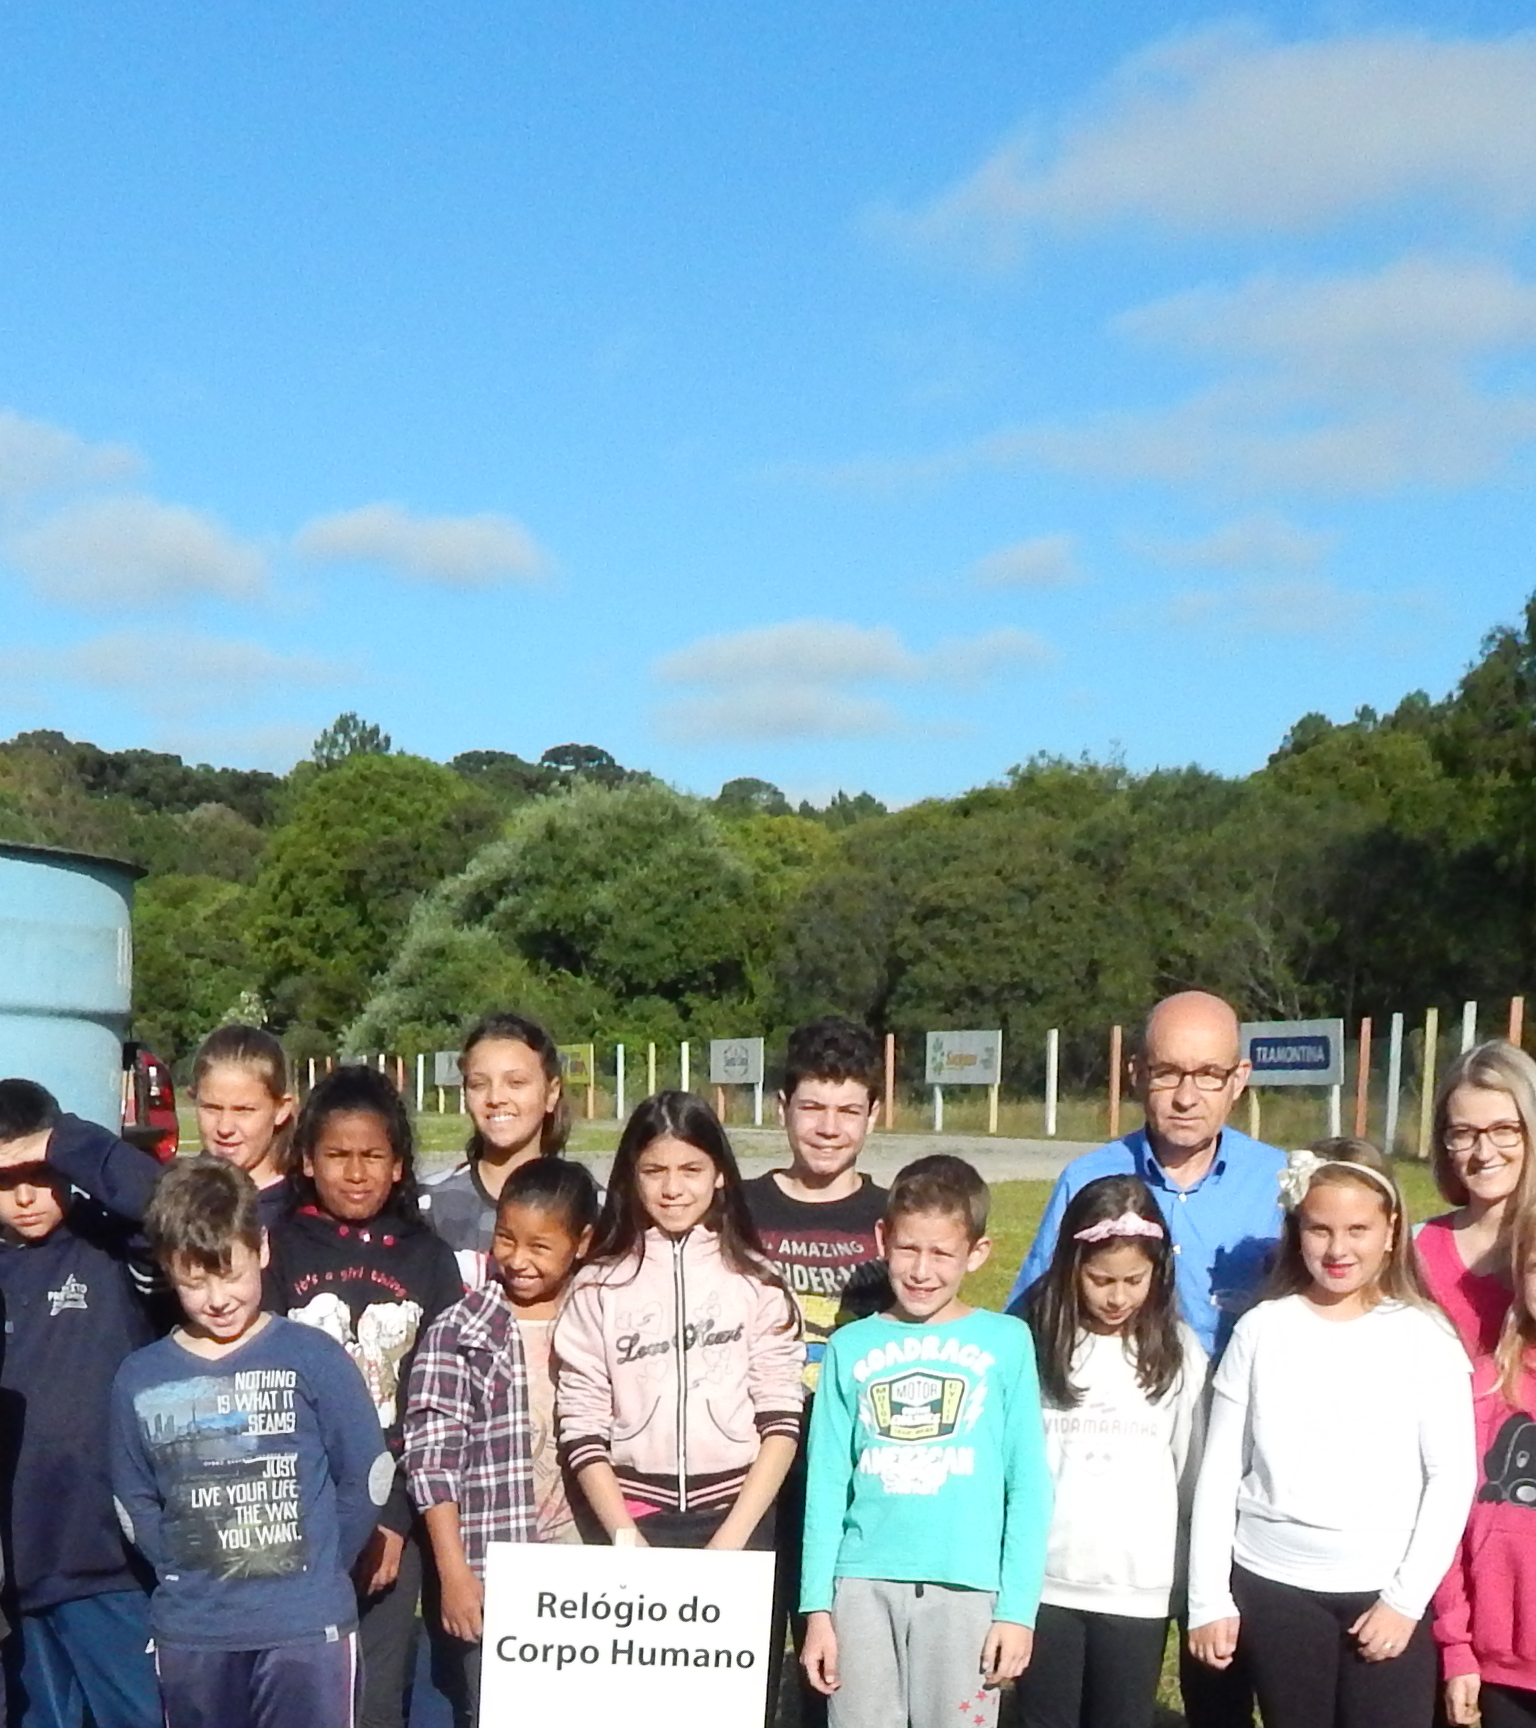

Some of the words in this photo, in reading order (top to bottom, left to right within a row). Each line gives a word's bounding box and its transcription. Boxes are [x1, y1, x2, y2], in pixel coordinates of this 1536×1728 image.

[1256, 1045, 1325, 1063] TRAMONTINA
[778, 1238, 864, 1257] AMAZING
[340, 1266, 364, 1281] girl
[234, 1370, 296, 1390] NOTHING
[217, 1395, 230, 1414] IS
[234, 1390, 278, 1411] WHAT
[283, 1390, 294, 1409] IT
[248, 1412, 296, 1433] SEAMS
[262, 1457, 297, 1478] JUST
[191, 1487, 221, 1508] LIVE
[226, 1481, 267, 1504] YOUR
[272, 1479, 298, 1499] LIFE
[234, 1506, 261, 1525] THE
[265, 1501, 298, 1521] WAY
[218, 1528, 250, 1549] YOU
[255, 1522, 302, 1546] WANT.
[536, 1592, 667, 1628] Relógio
[678, 1596, 721, 1623] do
[496, 1636, 600, 1671] Corpo
[611, 1639, 755, 1669] Humano
